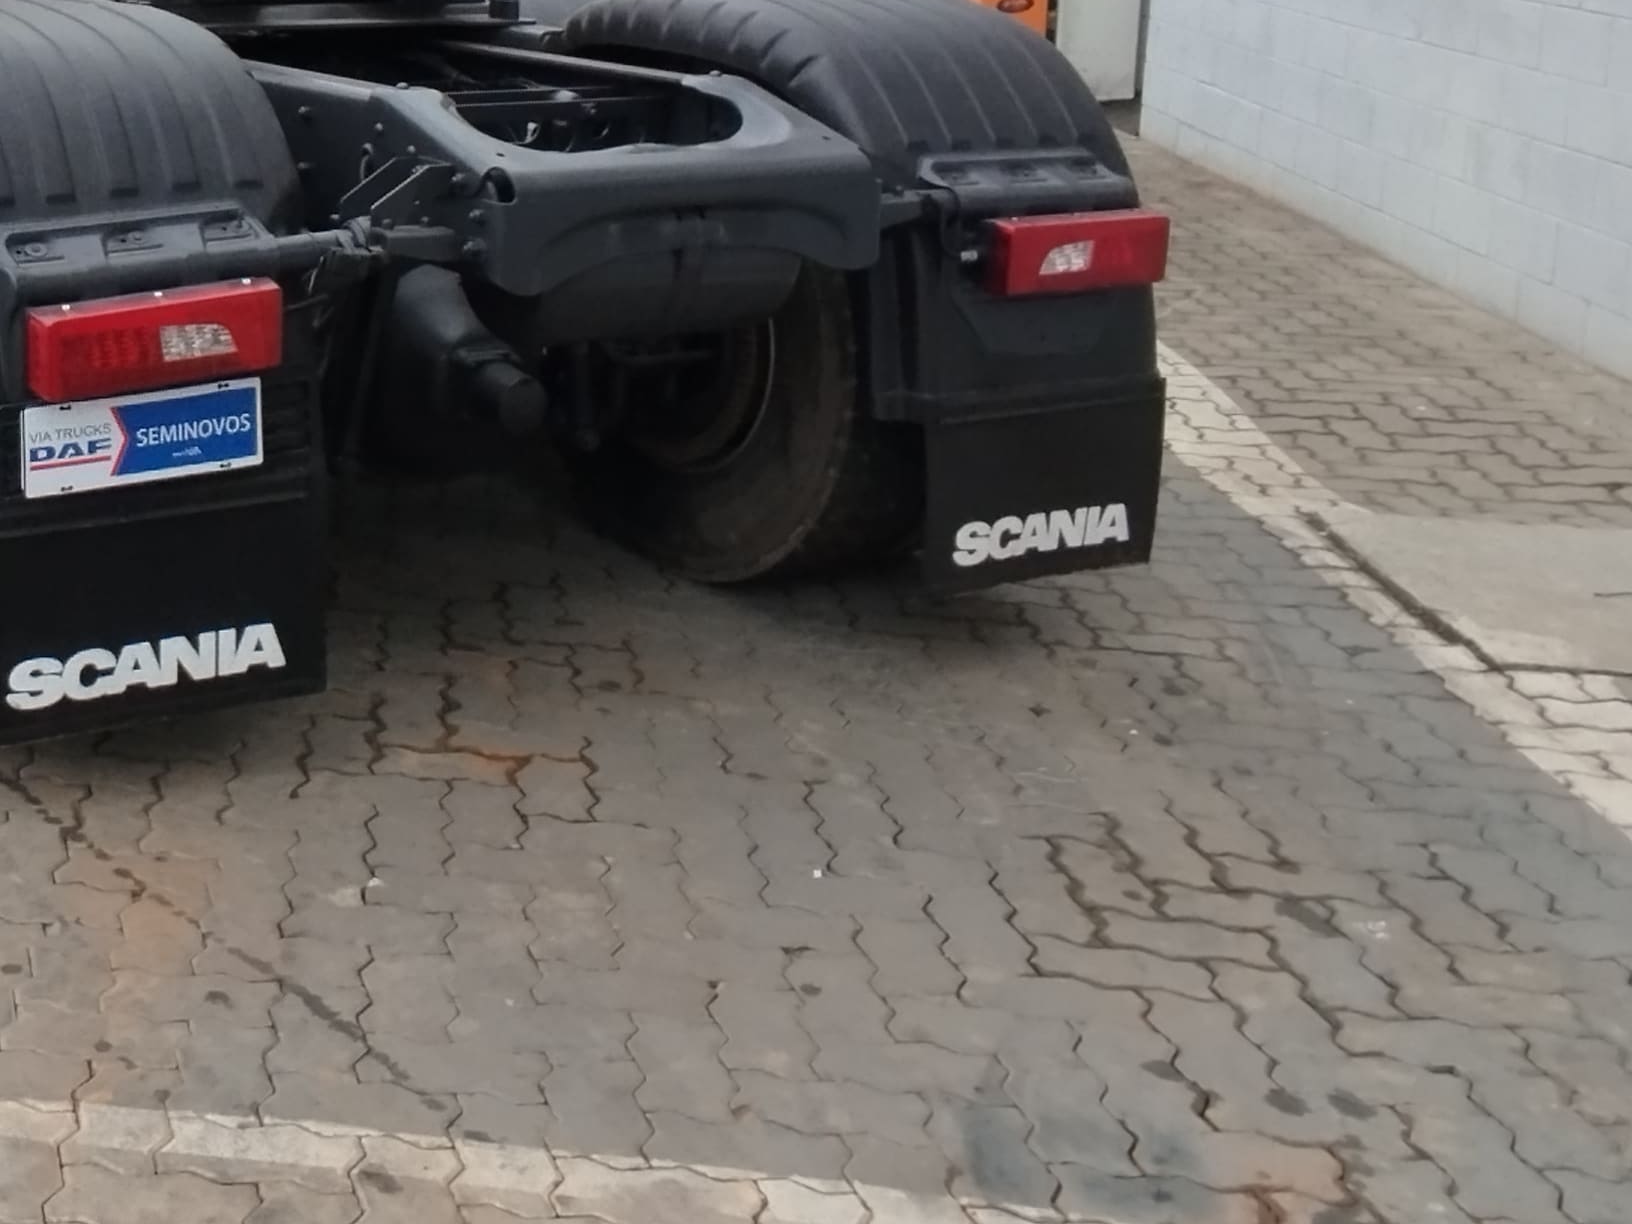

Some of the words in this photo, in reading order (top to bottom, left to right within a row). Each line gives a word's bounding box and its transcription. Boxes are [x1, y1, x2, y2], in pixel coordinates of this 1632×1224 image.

[29, 432, 52, 444] VIA
[55, 423, 112, 440] TRUCKS
[136, 413, 251, 447] SEMINOVOS
[29, 438, 112, 462] DAF
[952, 503, 1130, 567] SCANIA
[5, 623, 286, 710] SCANIA
